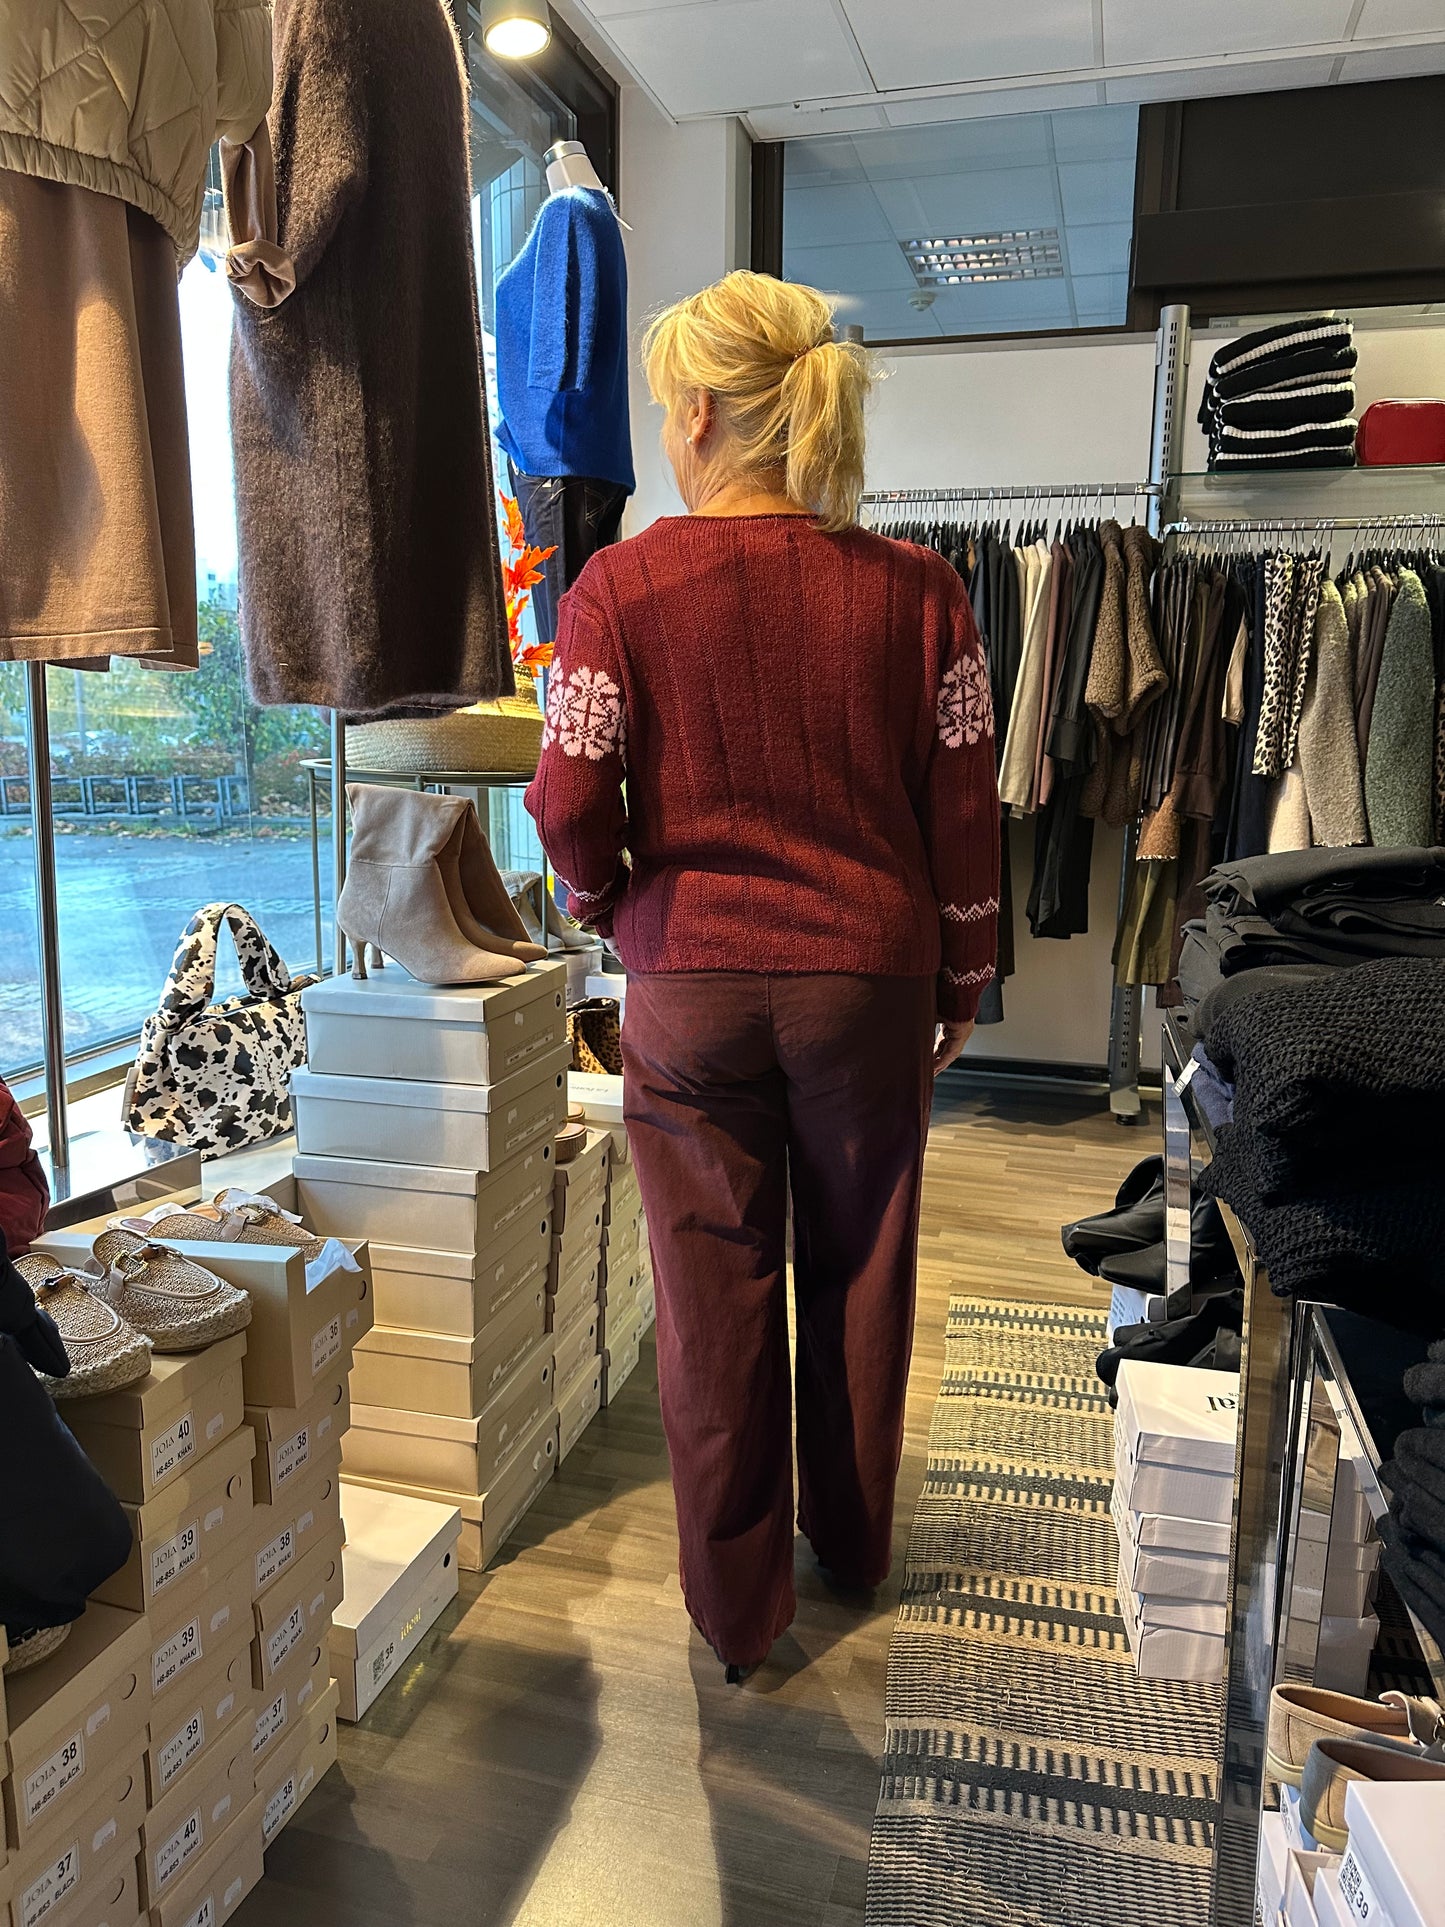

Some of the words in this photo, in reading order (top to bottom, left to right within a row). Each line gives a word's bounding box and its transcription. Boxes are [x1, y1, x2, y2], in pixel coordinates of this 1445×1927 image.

[330, 1321, 338, 1339] 36
[155, 1436, 175, 1458] JOIA
[178, 1420, 190, 1440] 40
[177, 1442, 193, 1460] KHAKI
[279, 1445, 295, 1463] JOIA
[297, 1431, 307, 1449] 38
[155, 1546, 177, 1568] JOIA
[181, 1529, 194, 1550] 39
[179, 1551, 196, 1570] KHAKI
[259, 1547, 277, 1567] JOIA
[280, 1532, 290, 1551] 38
[290, 1609, 298, 1629] 37
[400, 1607, 421, 1640] ideal
[156, 1645, 178, 1667] JOIA
[182, 1626, 194, 1647] 39
[180, 1647, 197, 1666] KHAKI
[385, 1642, 394, 1659] 36
[256, 1717, 269, 1733] OIA
[273, 1698, 282, 1717] 37
[163, 1740, 183, 1765] JOIA
[187, 1719, 198, 1740] 39
[186, 1737, 201, 1758] KHAKI
[29, 1765, 57, 1794] JOIA
[61, 1741, 77, 1767] 38
[60, 1763, 81, 1789] BLACK
[283, 1780, 293, 1800] 38
[160, 1840, 180, 1865] JOIA
[184, 1818, 196, 1839] 40
[183, 1837, 199, 1858] KHAKI
[25, 1878, 52, 1909] JOIA
[57, 1852, 72, 1878] 37
[54, 1874, 75, 1900] BLACK
[197, 1903, 208, 1925] 41
[1355, 1890, 1369, 1919] 39
